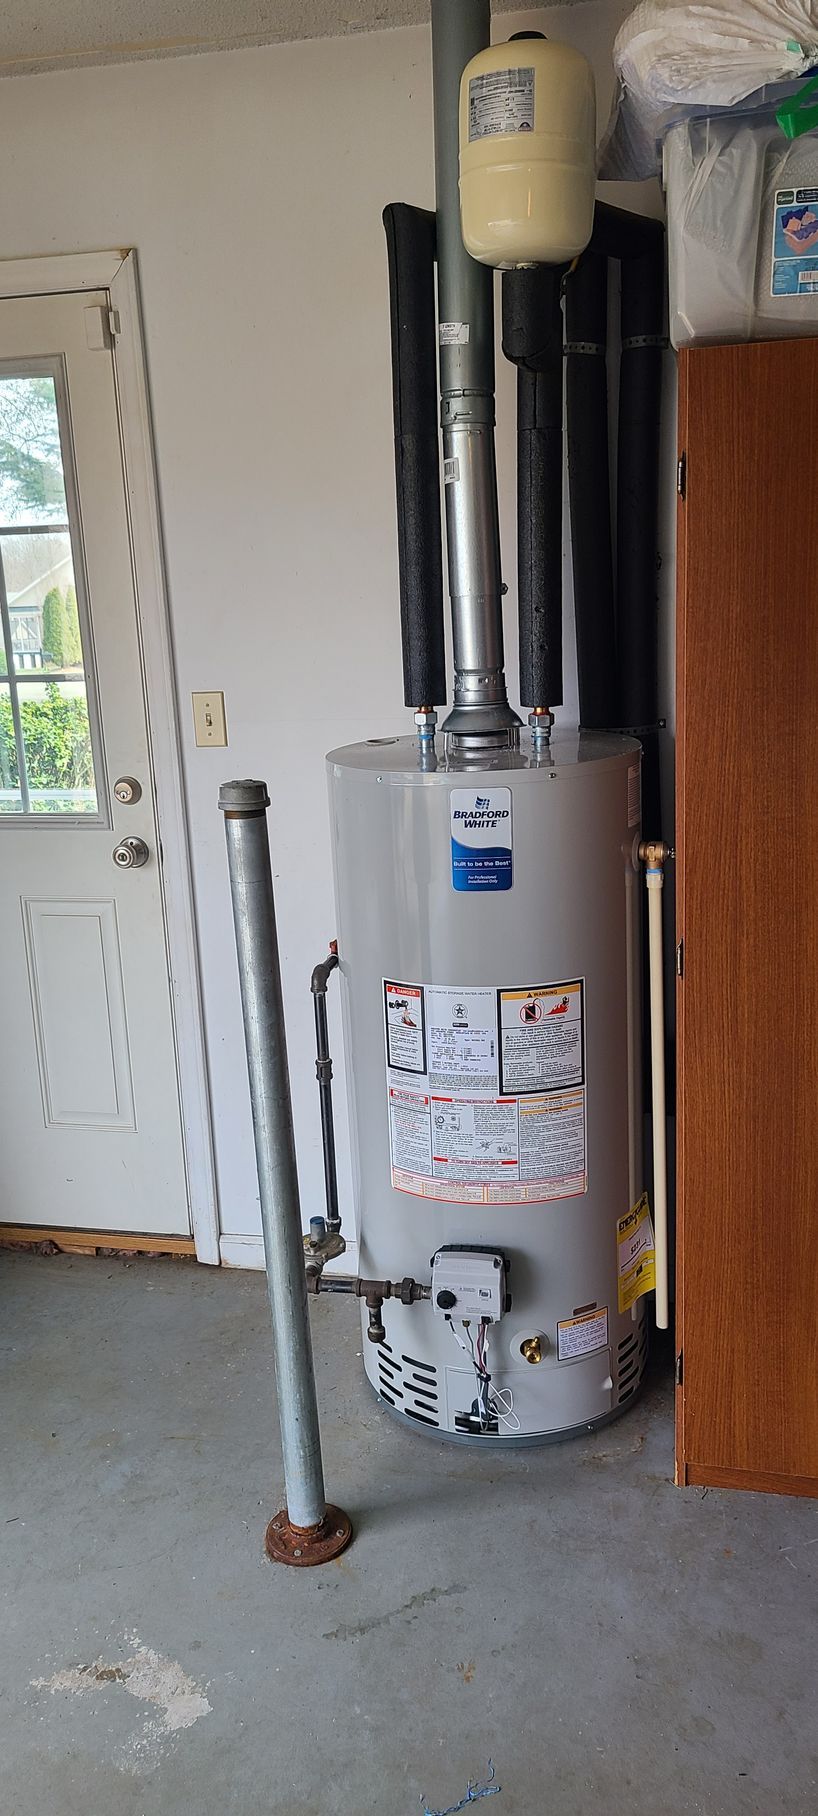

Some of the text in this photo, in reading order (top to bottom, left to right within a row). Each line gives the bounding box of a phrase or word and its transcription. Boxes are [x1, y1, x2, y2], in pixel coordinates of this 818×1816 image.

[453, 810, 510, 819] BRADFORD
[464, 819, 498, 828] WHITE
[396, 987, 417, 997] DANGER
[533, 989, 558, 998] WARNING
